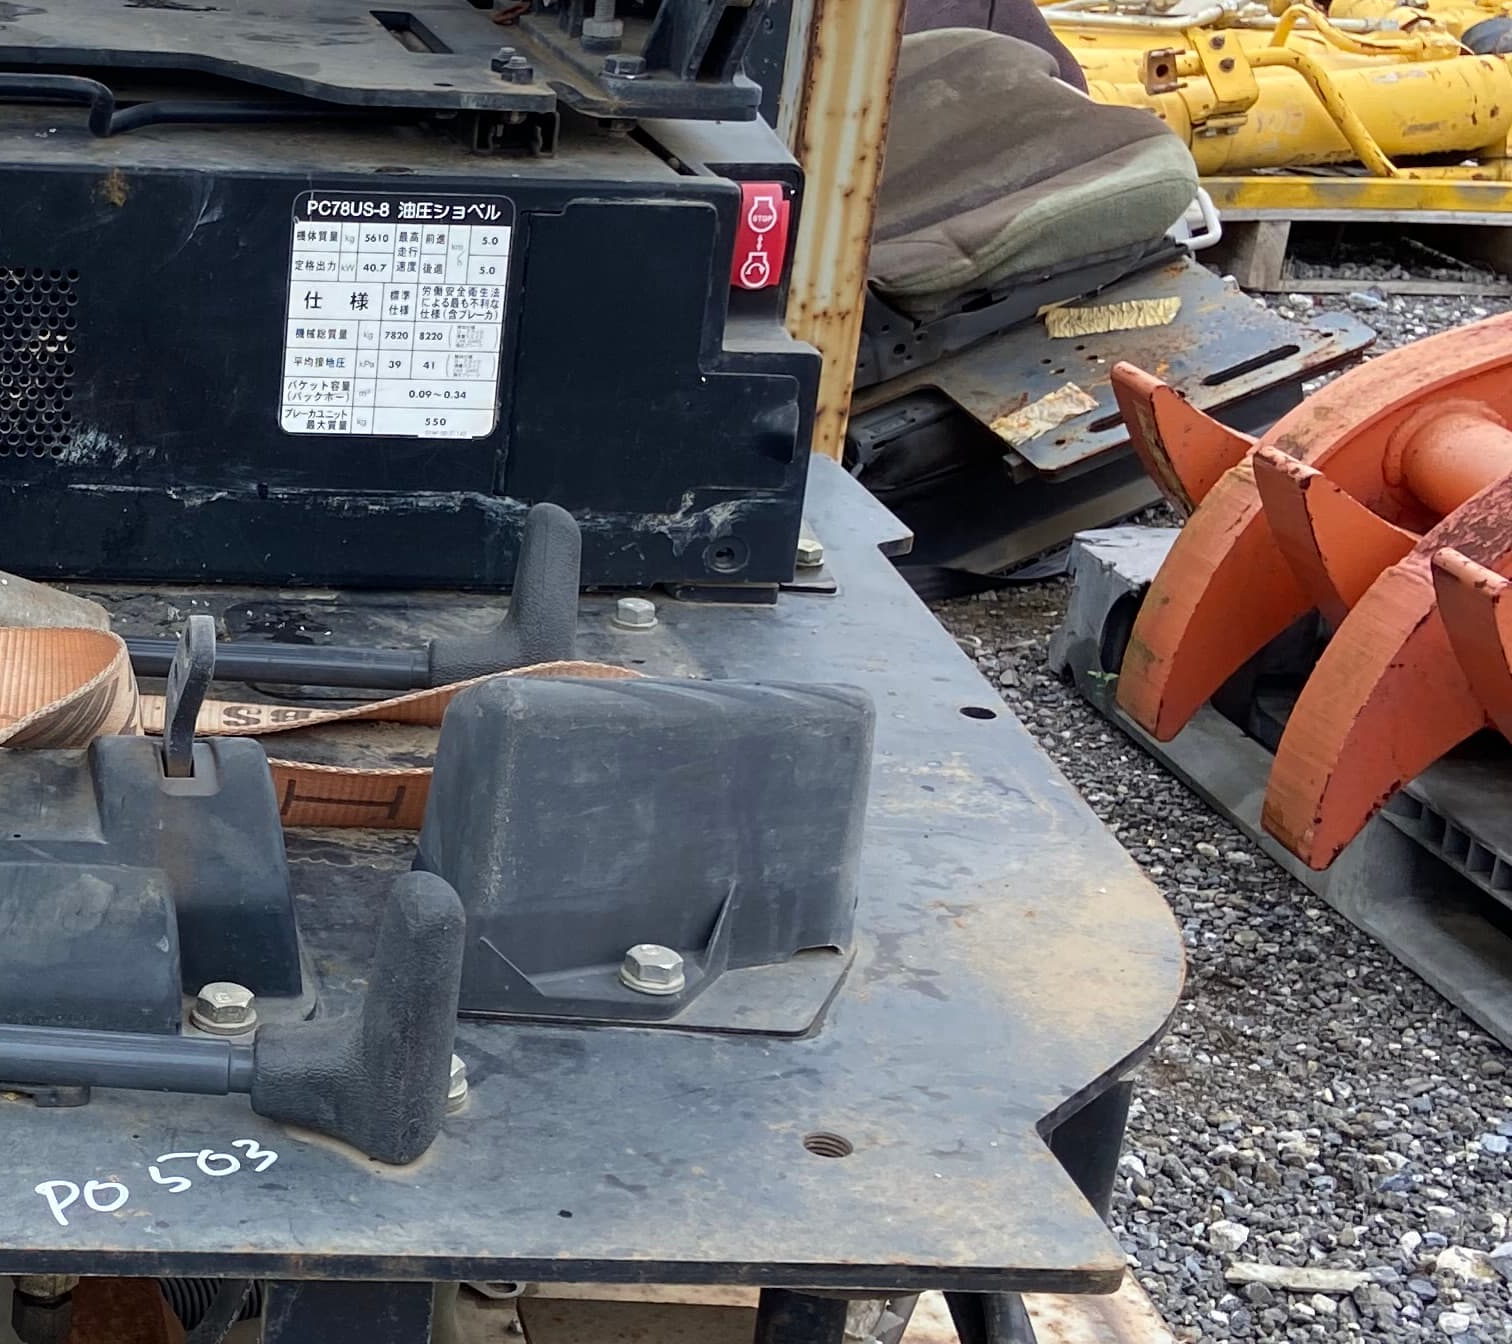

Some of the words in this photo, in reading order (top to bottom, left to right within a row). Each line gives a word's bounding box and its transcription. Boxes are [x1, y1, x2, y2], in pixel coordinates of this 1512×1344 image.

[307, 200, 390, 217] PC78US-8
[397, 202, 501, 221] 油圧ショベル
[752, 214, 773, 223] STOP
[296, 230, 339, 243] 機体質量
[364, 233, 389, 243] 5610
[398, 231, 419, 243] 最高
[482, 236, 499, 246] 5.0
[397, 246, 418, 258] 走行
[294, 259, 337, 272] 定格出力
[363, 263, 387, 272] 40.7
[395, 260, 417, 273] 速度
[479, 265, 496, 275] 5.0
[422, 286, 500, 298] 労働安全衛生法
[389, 304, 409, 316] 仕様
[295, 328, 348, 340] 機械総質量
[384, 331, 409, 340] 7820
[418, 332, 443, 341] 8220
[293, 356, 346, 368] 平均接地圧
[388, 360, 402, 369] 39
[422, 361, 436, 370] 41
[287, 379, 351, 392] バケット容量
[284, 408, 348, 419] ブレーカユニット
[305, 419, 347, 431] 最大質量
[425, 417, 447, 426] 550
[34, 1179, 129, 1226] PO
[148, 1138, 278, 1193] 503
